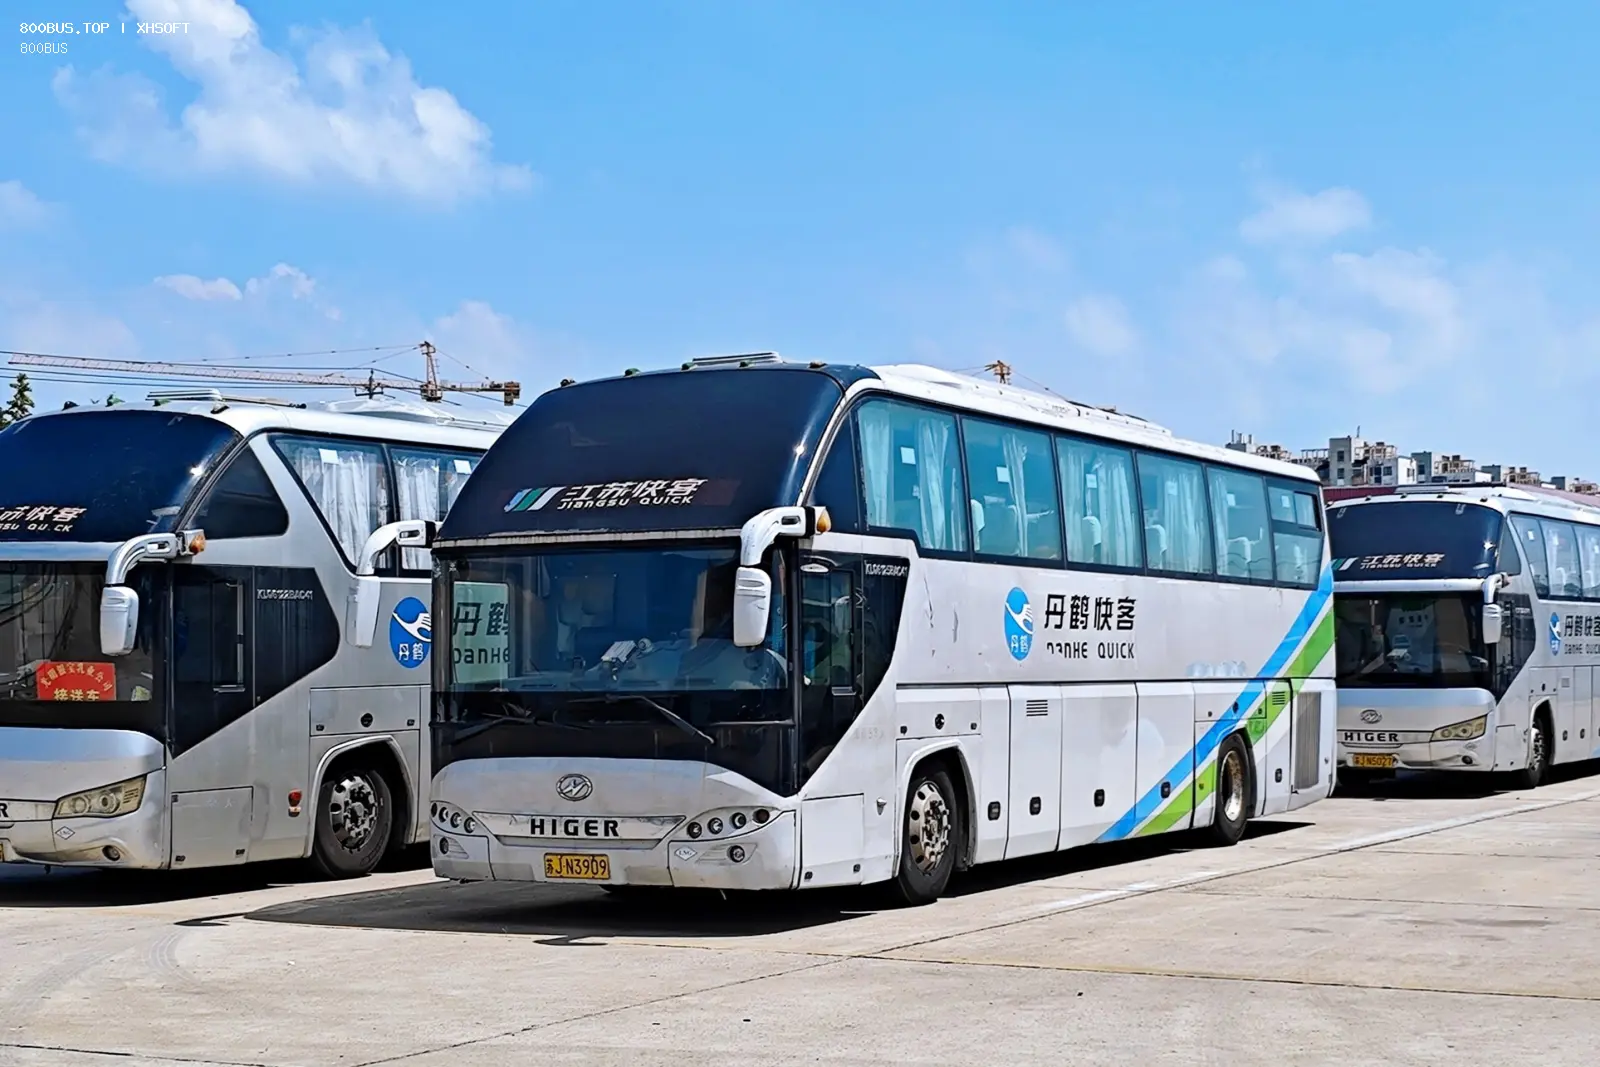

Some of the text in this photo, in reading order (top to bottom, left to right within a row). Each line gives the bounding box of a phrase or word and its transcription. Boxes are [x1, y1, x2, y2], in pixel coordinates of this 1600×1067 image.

[561, 478, 708, 502] 江苏快客
[640, 496, 693, 504] QUICK
[27, 523, 73, 532] QUCK
[1044, 594, 1137, 631] 丹鹤快客
[1098, 642, 1135, 659] QUICK
[53, 688, 100, 701] 接送车
[1344, 732, 1399, 742] HIGER
[531, 818, 619, 837] HIGER
